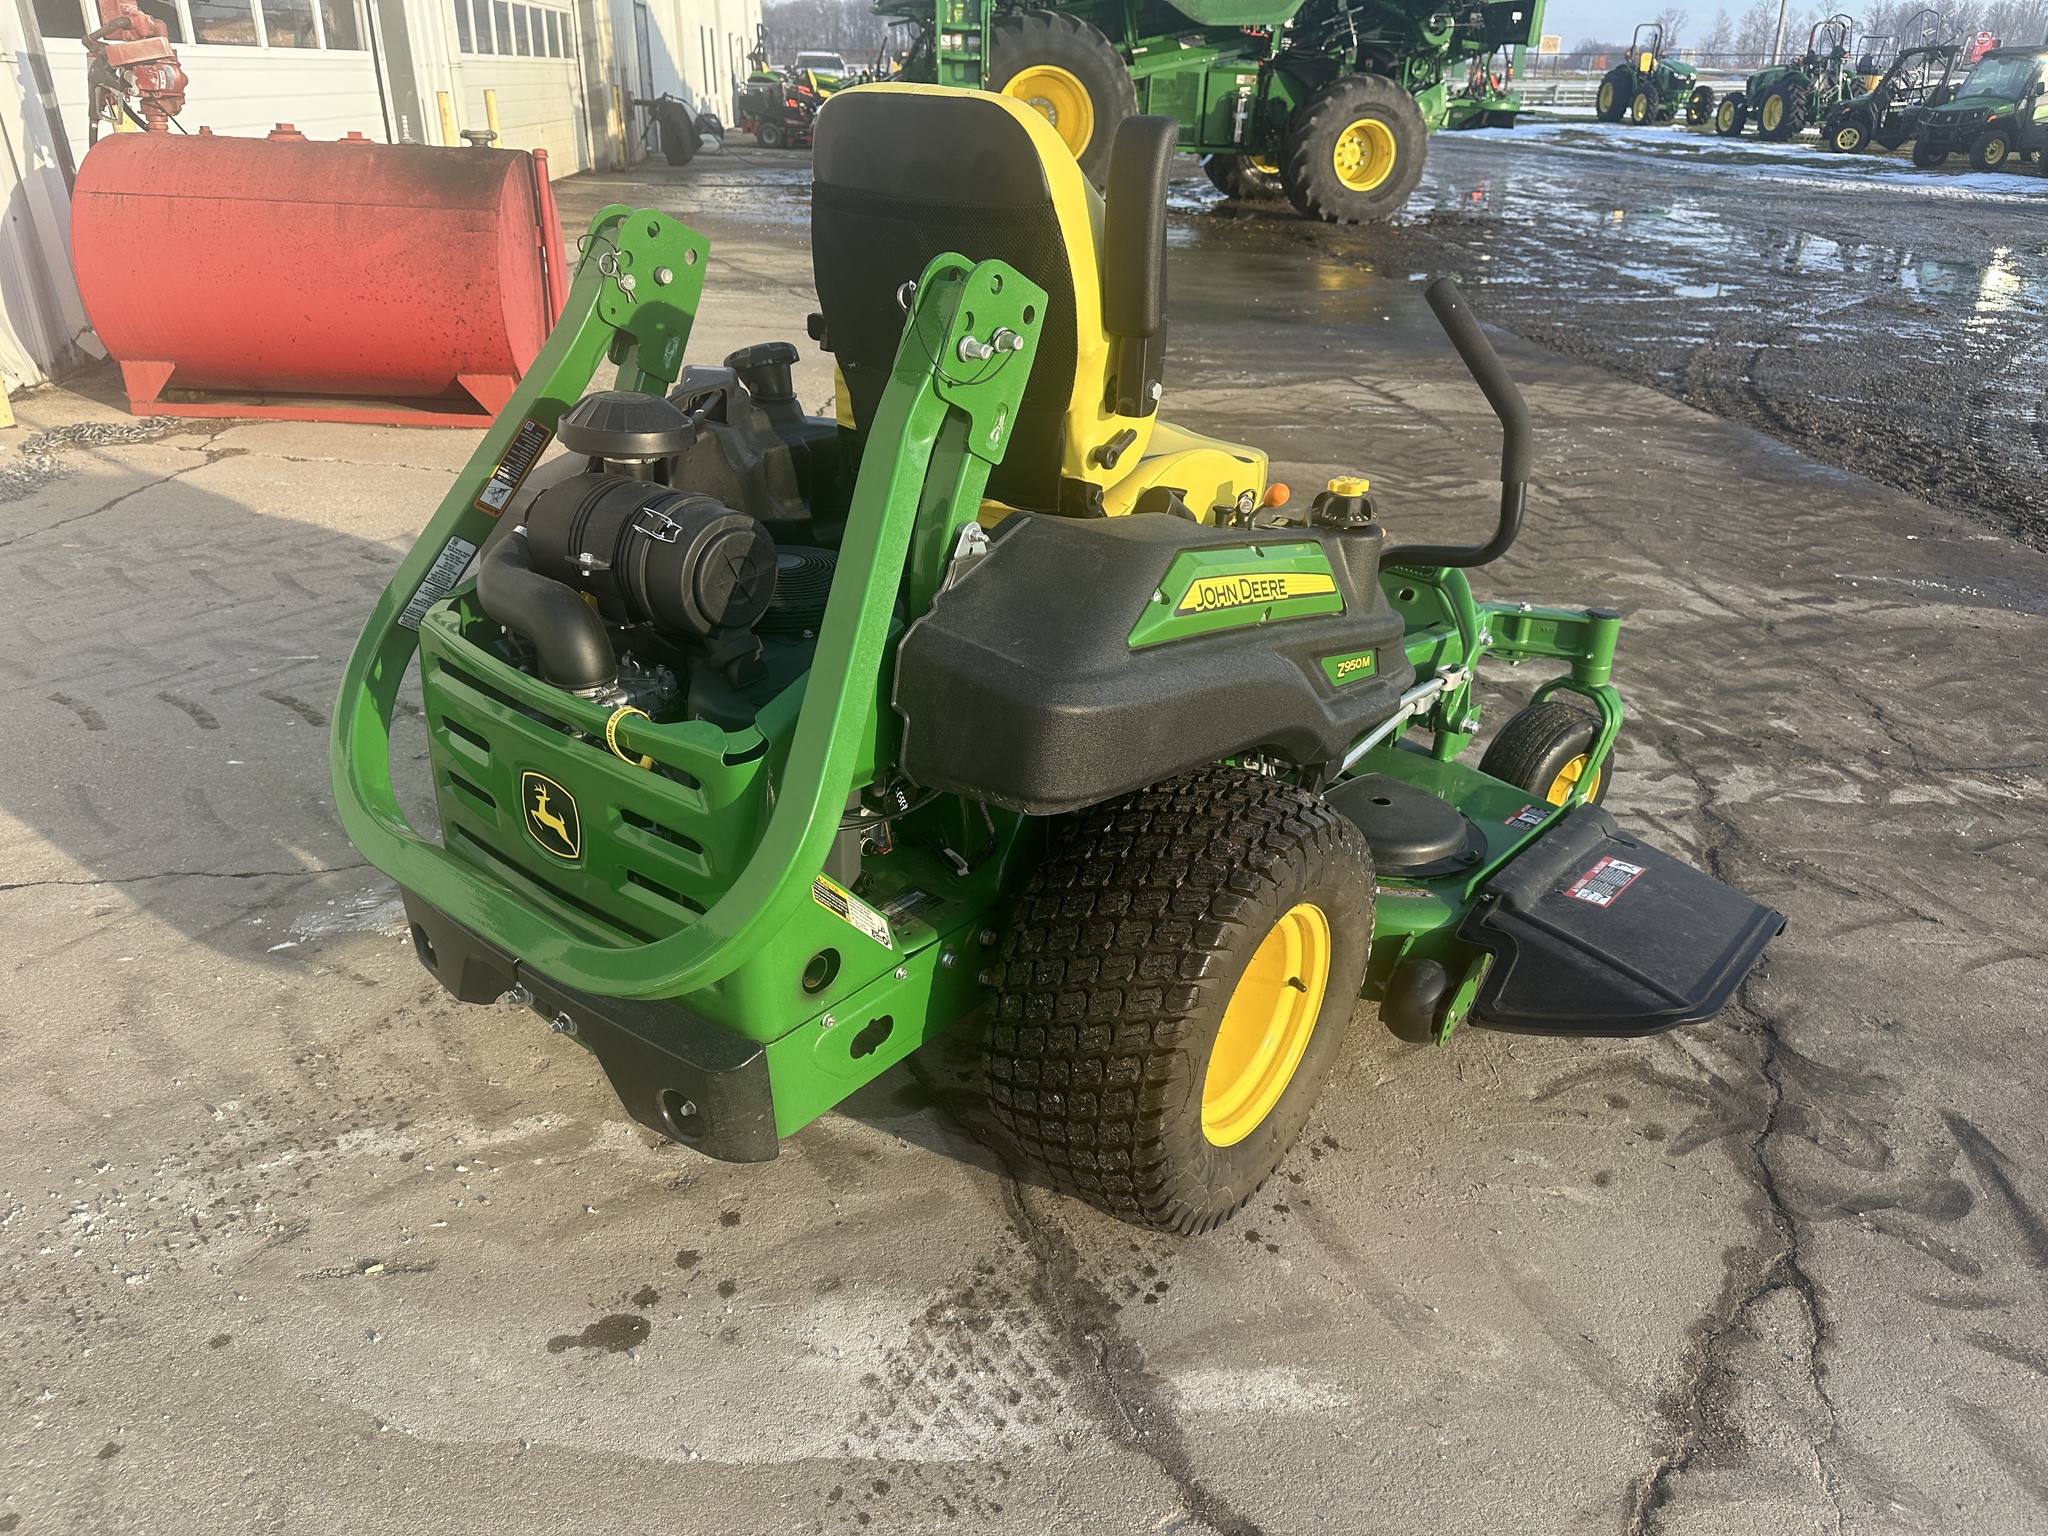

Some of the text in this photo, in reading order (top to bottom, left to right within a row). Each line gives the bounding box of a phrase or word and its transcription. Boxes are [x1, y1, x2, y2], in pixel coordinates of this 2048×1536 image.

[1197, 579, 1287, 607] JOHN DEERE
[1337, 656, 1370, 678] Z950M
